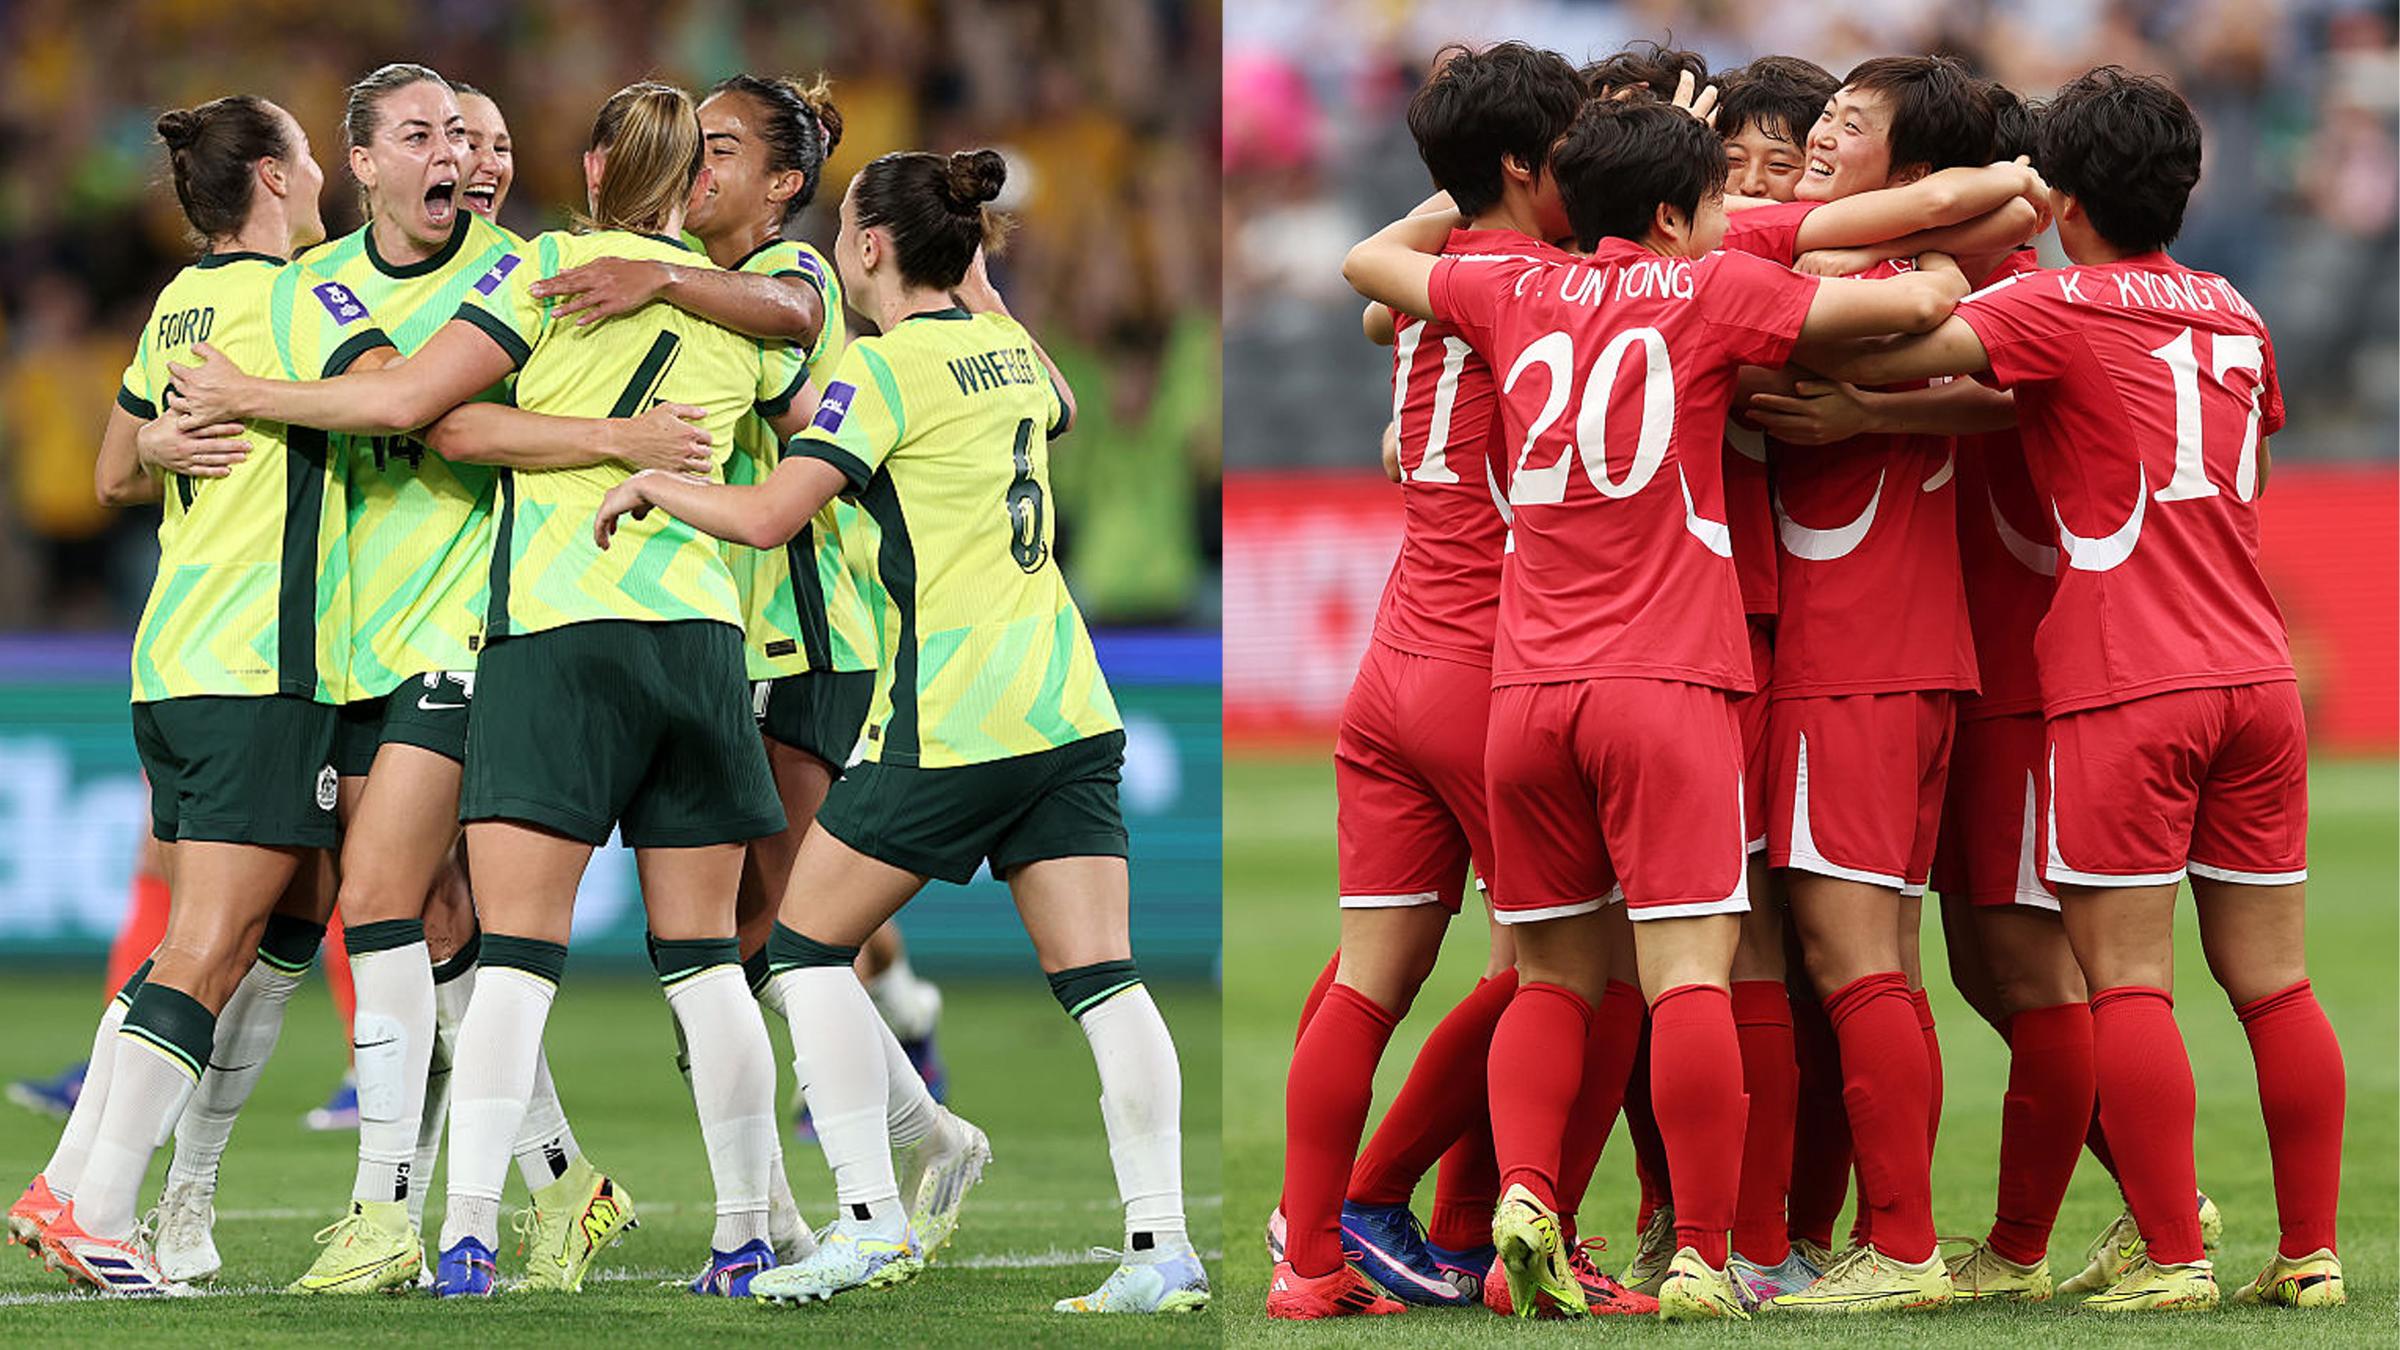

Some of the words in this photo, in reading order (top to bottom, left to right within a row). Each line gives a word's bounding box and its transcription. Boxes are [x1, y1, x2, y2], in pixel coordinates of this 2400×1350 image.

[1560, 264, 1611, 307] UN
[1615, 260, 1694, 301] YONG
[2112, 271, 2216, 311] KYONG
[1393, 319, 1473, 484] 11
[1503, 326, 1676, 506] 20
[2150, 326, 2266, 503] 17
[1006, 417, 1049, 574] 6
